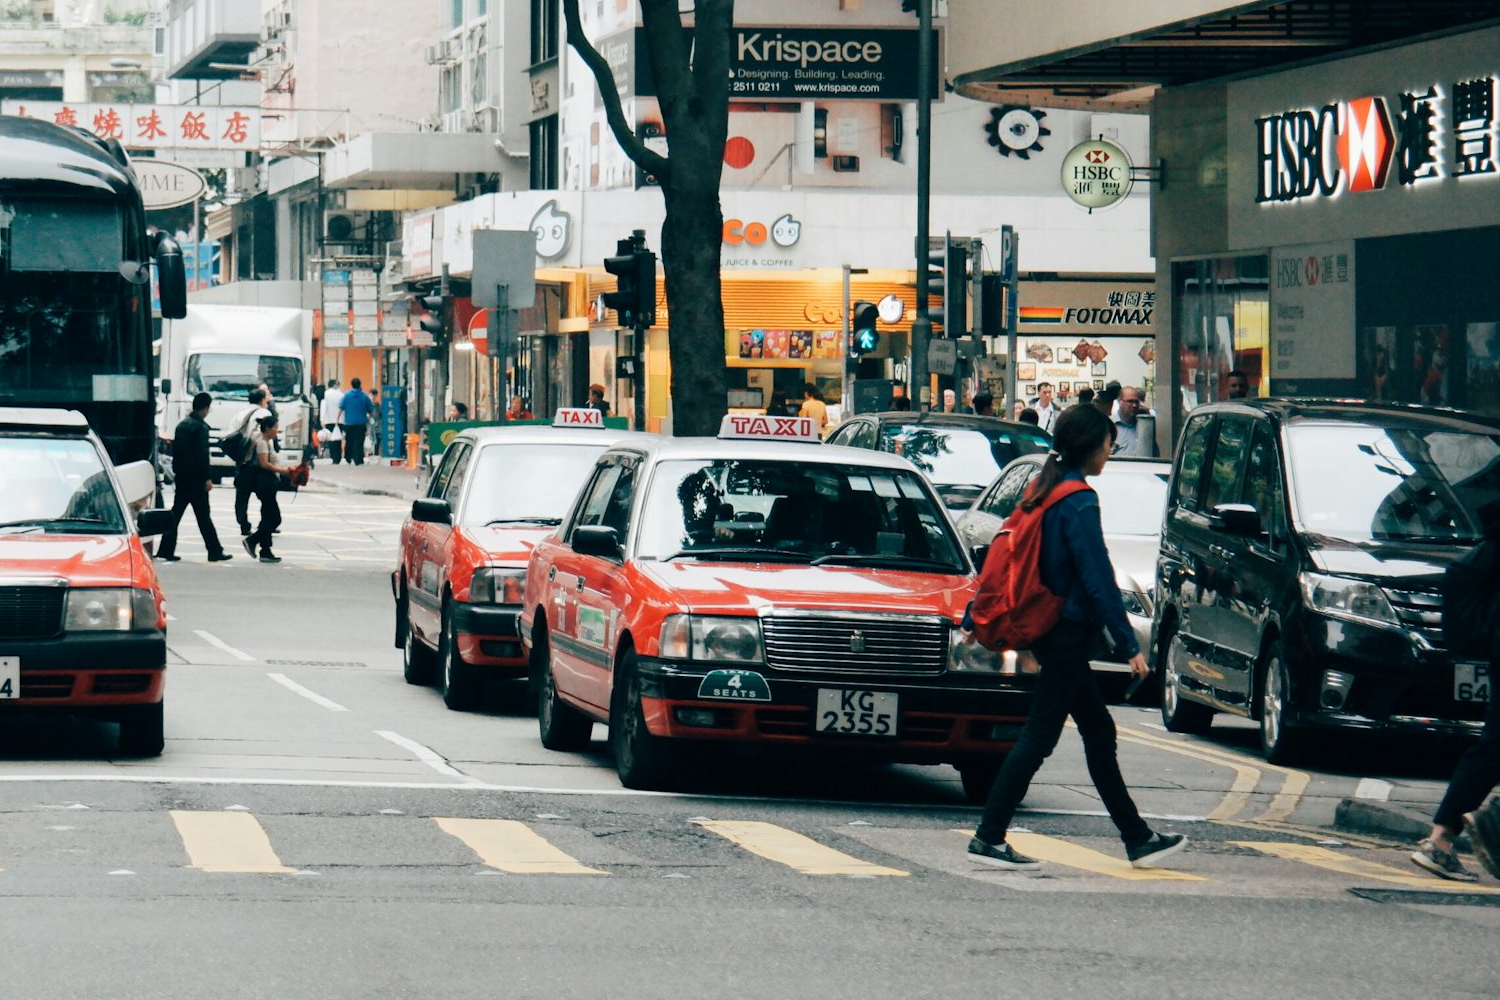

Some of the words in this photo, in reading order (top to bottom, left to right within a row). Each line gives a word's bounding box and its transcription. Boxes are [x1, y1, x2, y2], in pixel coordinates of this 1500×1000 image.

[737, 33, 882, 68] Krispace
[737, 69, 791, 80] Designing.
[794, 69, 838, 80] Building.
[841, 69, 885, 81] Leading.
[733, 82, 755, 91] 2511
[758, 82, 780, 91] 0211
[794, 83, 880, 93] www.krispace.com
[1255, 103, 1342, 203] HSBC
[1074, 166, 1121, 180] HSBC
[725, 258, 750, 266] JUICE
[760, 258, 794, 266] COFFEE
[1277, 257, 1303, 288] HSBC
[1064, 307, 1155, 325] FOTOMAX
[561, 411, 600, 424] TAXI
[731, 417, 811, 436] TAXI
[727, 675, 742, 689] 4
[1474, 664, 1489, 684] P
[713, 688, 756, 698] SEATS
[1458, 683, 1489, 701] 64
[841, 690, 874, 713] KG
[823, 711, 891, 734] 2355
